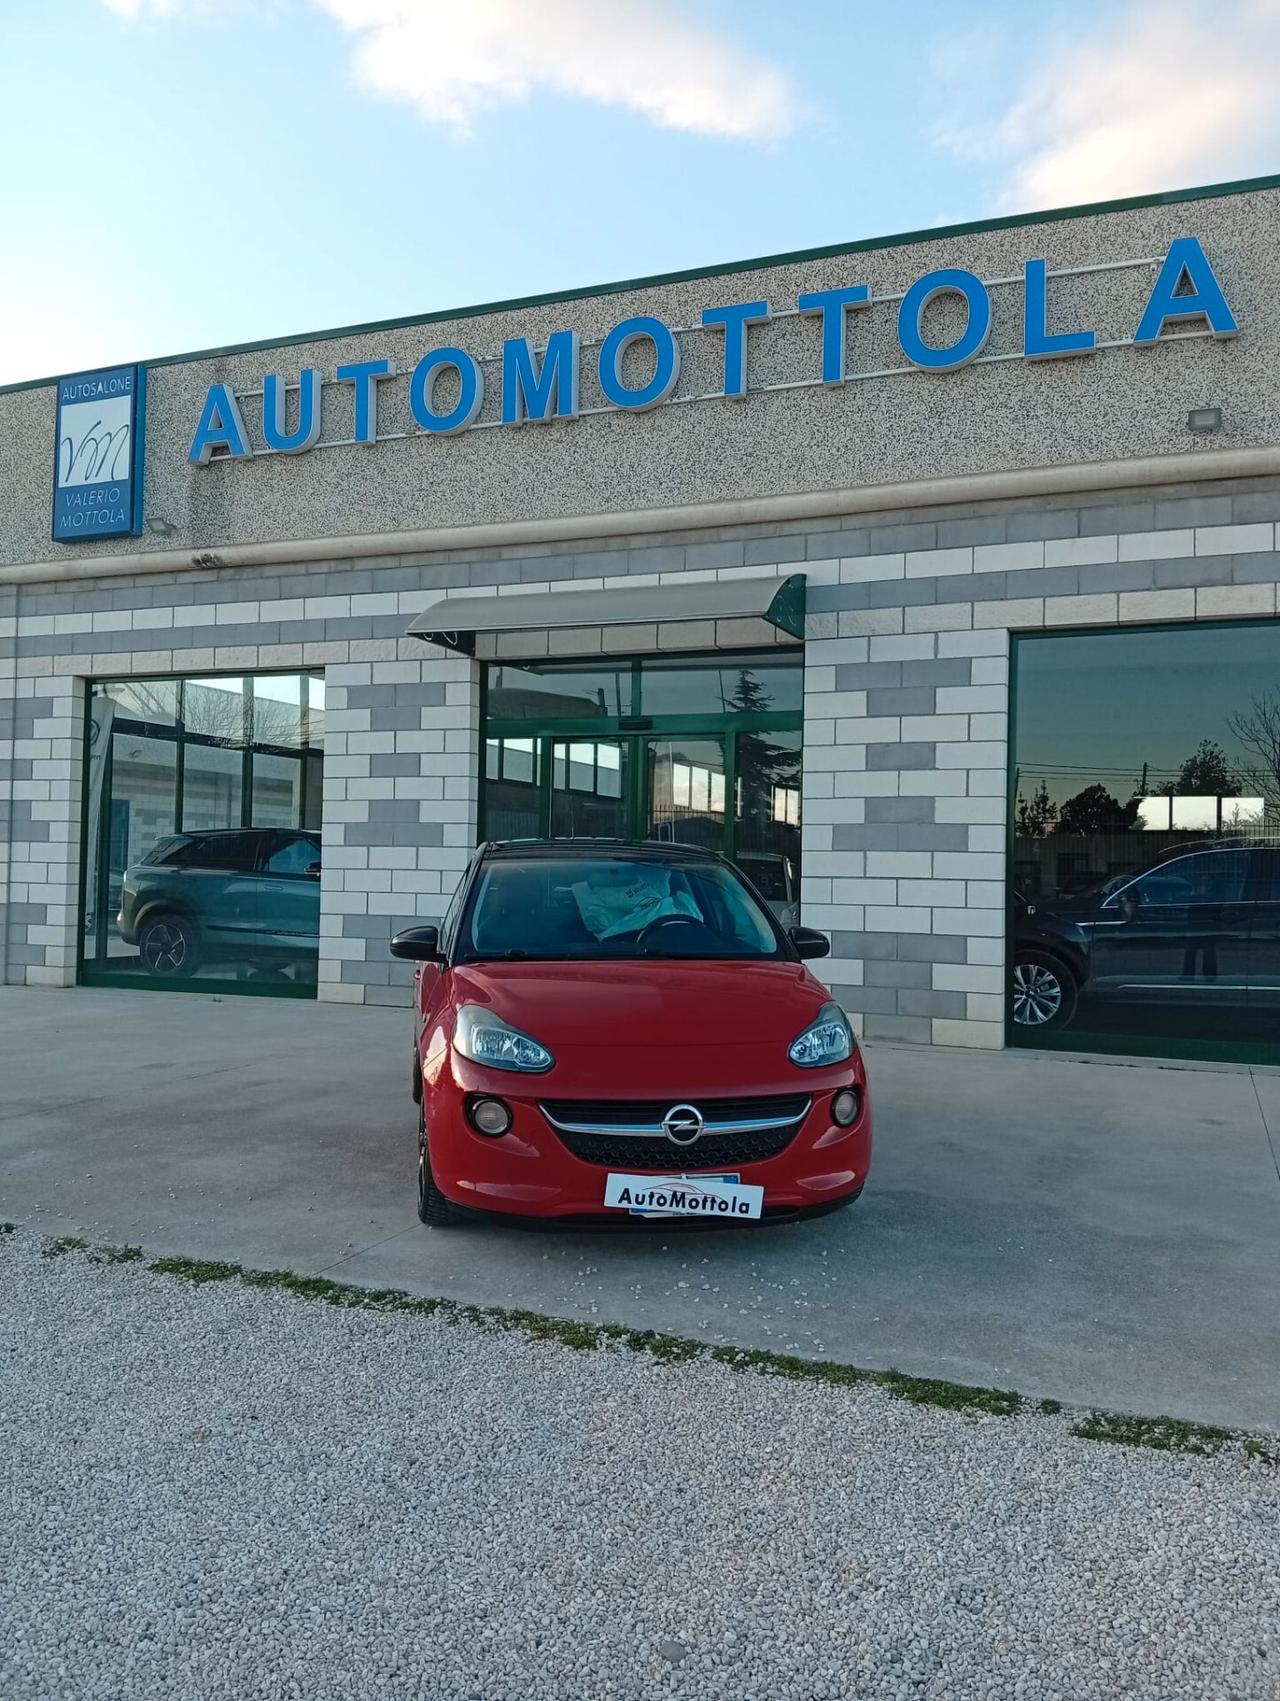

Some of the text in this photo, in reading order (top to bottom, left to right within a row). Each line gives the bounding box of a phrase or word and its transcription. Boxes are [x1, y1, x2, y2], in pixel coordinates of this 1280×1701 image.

[188, 236, 1239, 466] AUTOMOTTOLA
[62, 376, 132, 400] AUTOSALONE
[65, 487, 121, 507] VALERIO
[60, 509, 125, 529] MOTTOLA
[618, 1188, 750, 1215] AutoMottola
